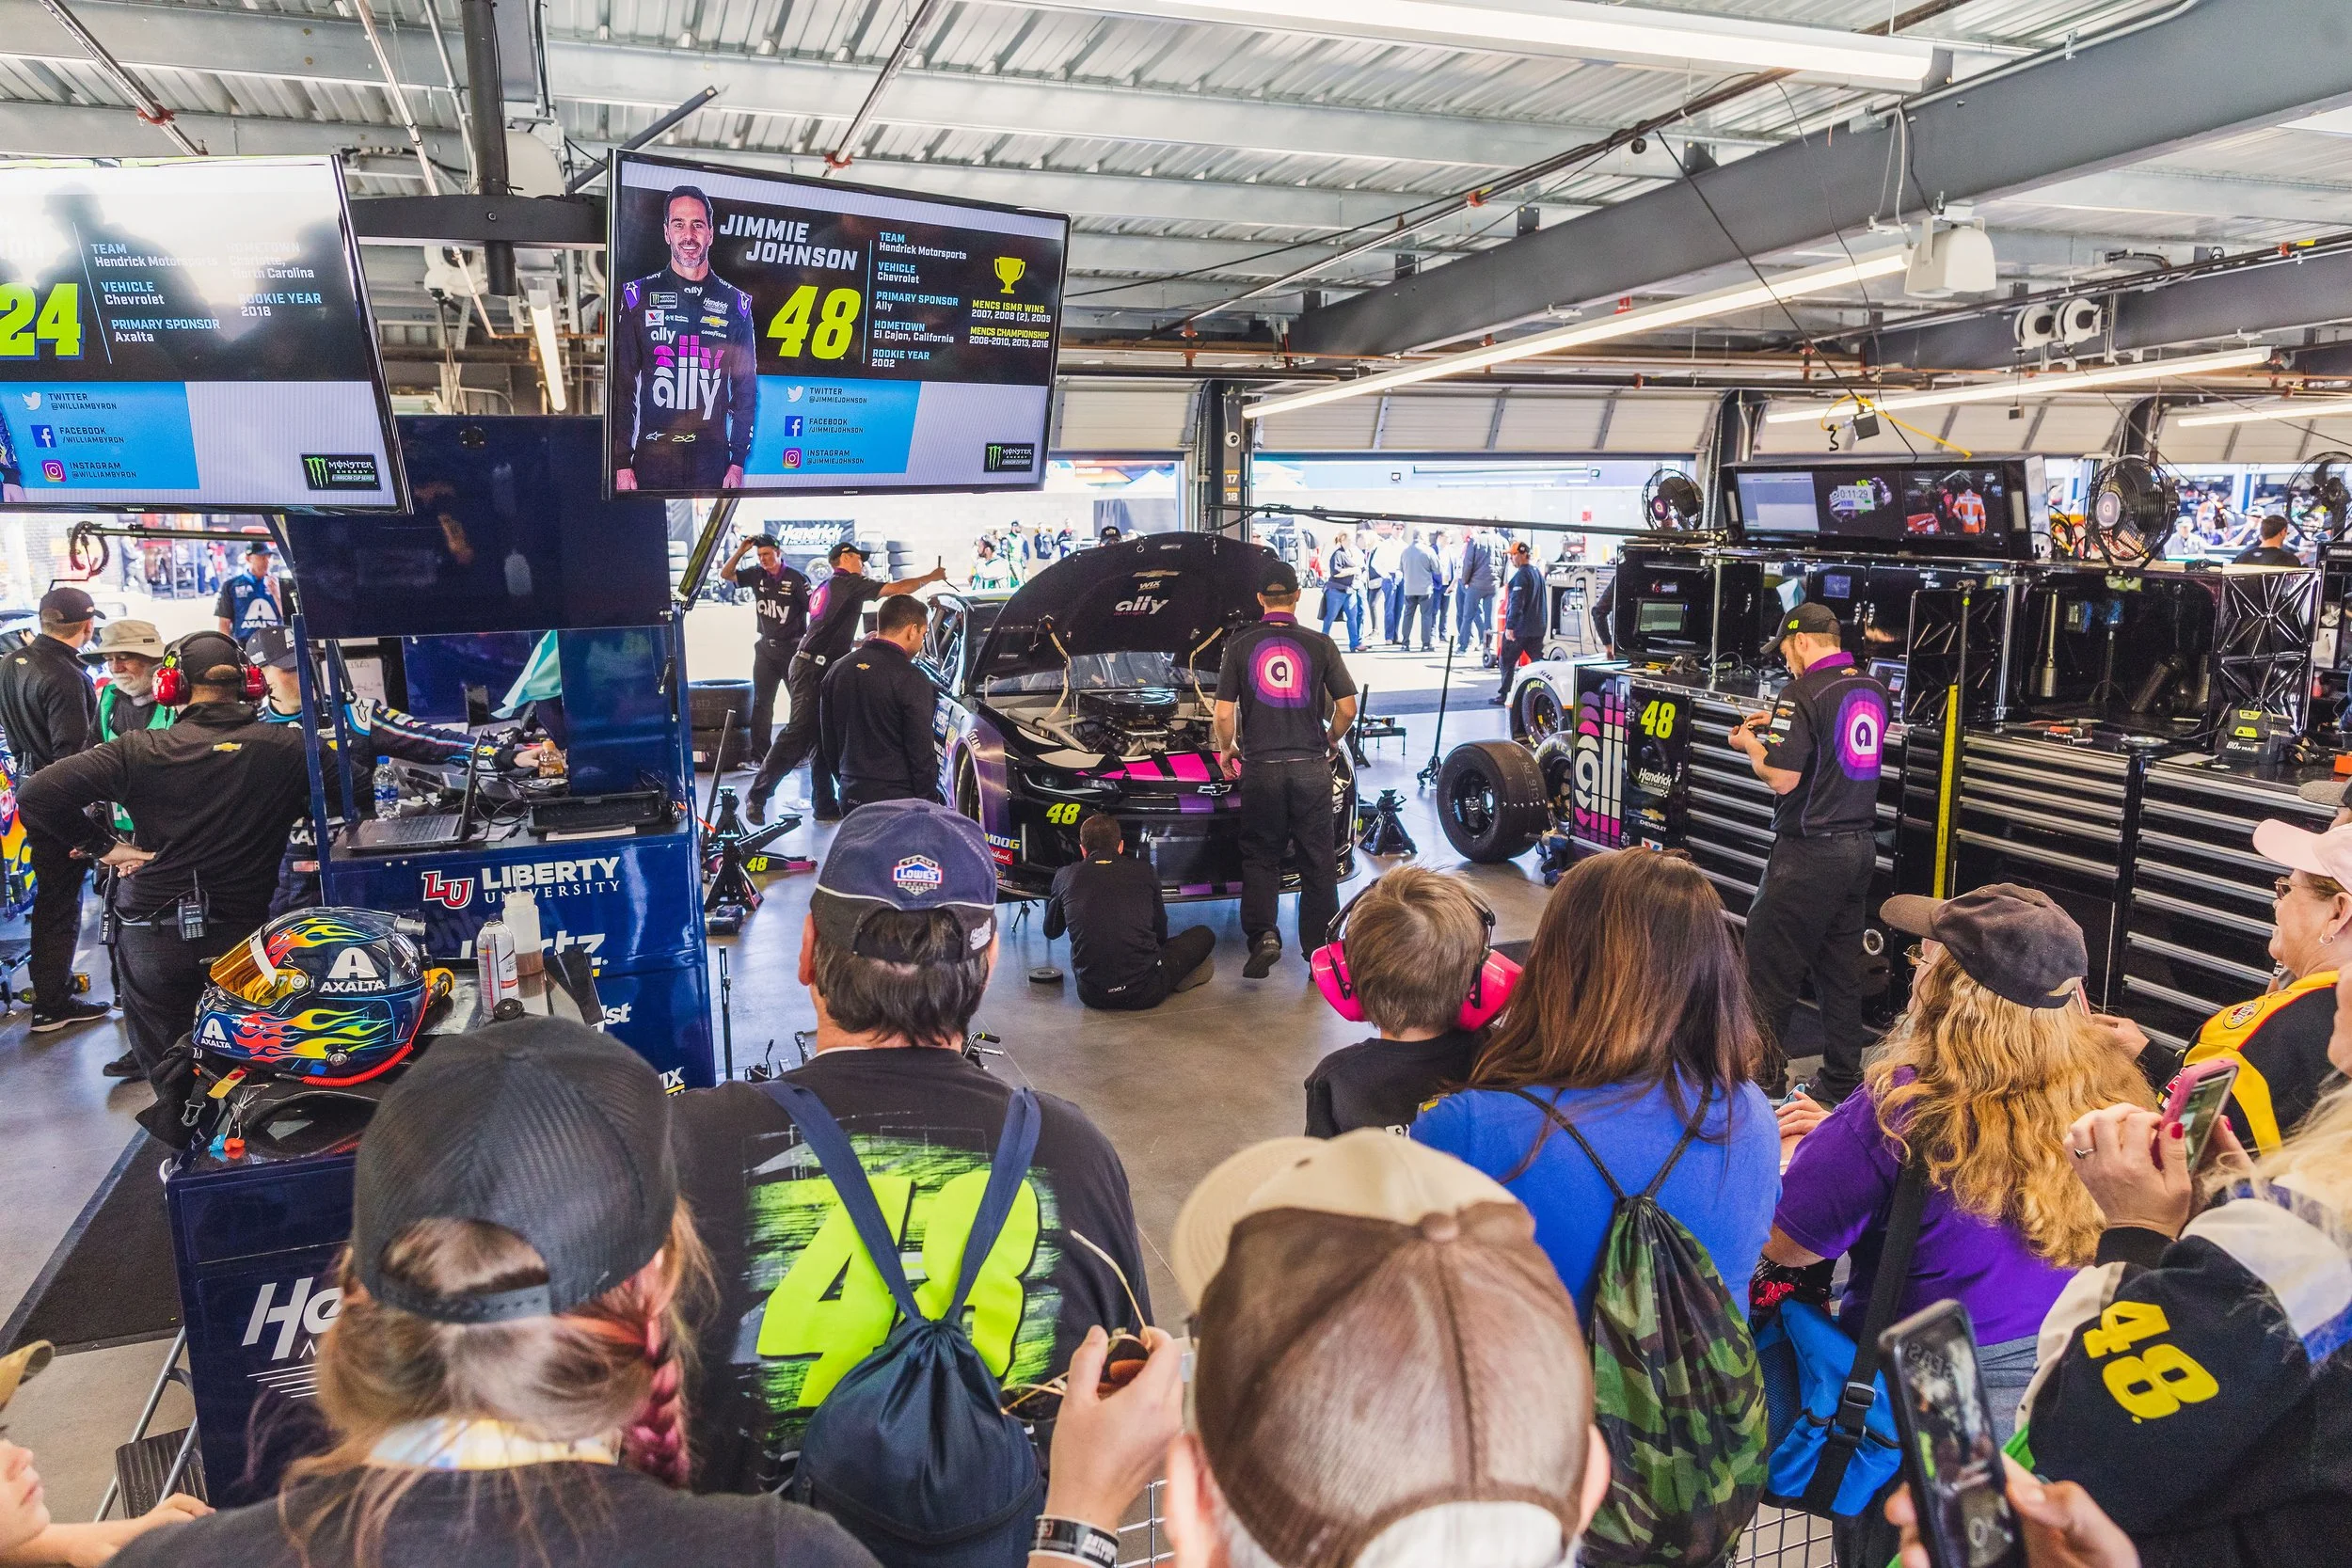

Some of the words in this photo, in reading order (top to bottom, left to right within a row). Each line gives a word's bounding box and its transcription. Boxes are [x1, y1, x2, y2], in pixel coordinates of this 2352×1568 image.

[720, 214, 810, 244] JIMMIE
[880, 231, 905, 244] TEAM
[91, 243, 127, 254] TEAM
[879, 242, 916, 255] Hendrick
[917, 245, 967, 261] Motorsports
[95, 256, 147, 267] Hendrick
[149, 256, 218, 269] Motorsports
[745, 241, 858, 271] JOHNSON
[267, 267, 314, 278] Carolina
[878, 261, 915, 274] VEHICLE
[877, 272, 919, 284] Chevrolet
[101, 281, 154, 293] VEHICLE
[683, 285, 704, 296] ally
[104, 293, 165, 306] Chevrolet
[238, 293, 285, 305] ROOKIE
[288, 293, 322, 304] YEAR
[876, 291, 916, 303] PRIMARY
[917, 293, 959, 307] SPONSOR
[241, 306, 271, 317] 2018
[875, 300, 893, 312] Ally
[972, 299, 1001, 310] MENCS
[1003, 301, 1023, 311] ISMR
[1025, 304, 1045, 314] WINS
[0, 282, 83, 356] 24
[766, 285, 862, 360] 48
[971, 309, 993, 320] 2007,
[1031, 313, 1052, 324] 2009
[111, 319, 164, 330] PRIMARY
[166, 318, 221, 330] SPONSOR
[874, 320, 926, 332] HOMETOWN
[115, 331, 154, 342] Axalta
[650, 326, 676, 344] ally
[873, 329, 881, 339] El
[884, 330, 912, 342] Cajon,
[913, 332, 955, 343] California
[970, 326, 996, 337] MENCS
[996, 327, 1050, 340] CHAMPIONSHIP
[1011, 338, 1031, 349] 2013,
[872, 348, 905, 359] ROOKIE
[907, 350, 930, 360] YEAR
[871, 358, 896, 369] 2002
[652, 344, 723, 420] ally
[48, 393, 88, 402] TWITTER
[809, 387, 843, 396] TWITTER
[809, 395, 867, 404] @JIMMIEJOHNSON
[51, 403, 118, 411] @WILLIAMBYRON
[809, 418, 848, 426] FACEBOOK
[808, 426, 864, 435] /JIMMIEJOHNSON
[807, 449, 850, 457] INSTAGRAM
[328, 460, 374, 470] MONSTER
[806, 457, 865, 466] @JIMMIEJOHNSON
[72, 471, 137, 480] @WILLIAMBYRON
[1226, 474, 1238, 484] 17
[1226, 492, 1239, 501] 18
[1139, 579, 1162, 590] WIX
[1115, 595, 1169, 615] ally
[756, 599, 790, 625] ally
[1526, 679, 1546, 692] EAGLE
[1640, 699, 1677, 739] 48
[1638, 768, 1673, 787] Hendrick
[1045, 802, 1081, 825] 48
[1639, 819, 1667, 832] CHEVROLET
[746, 857, 769, 872] 48
[481, 856, 620, 890] LIBERTY
[318, 979, 387, 993] AXALTA
[200, 1037, 232, 1050] AXALTA
[755, 1170, 1039, 1408] 48
[2083, 1300, 2219, 1421] 48
